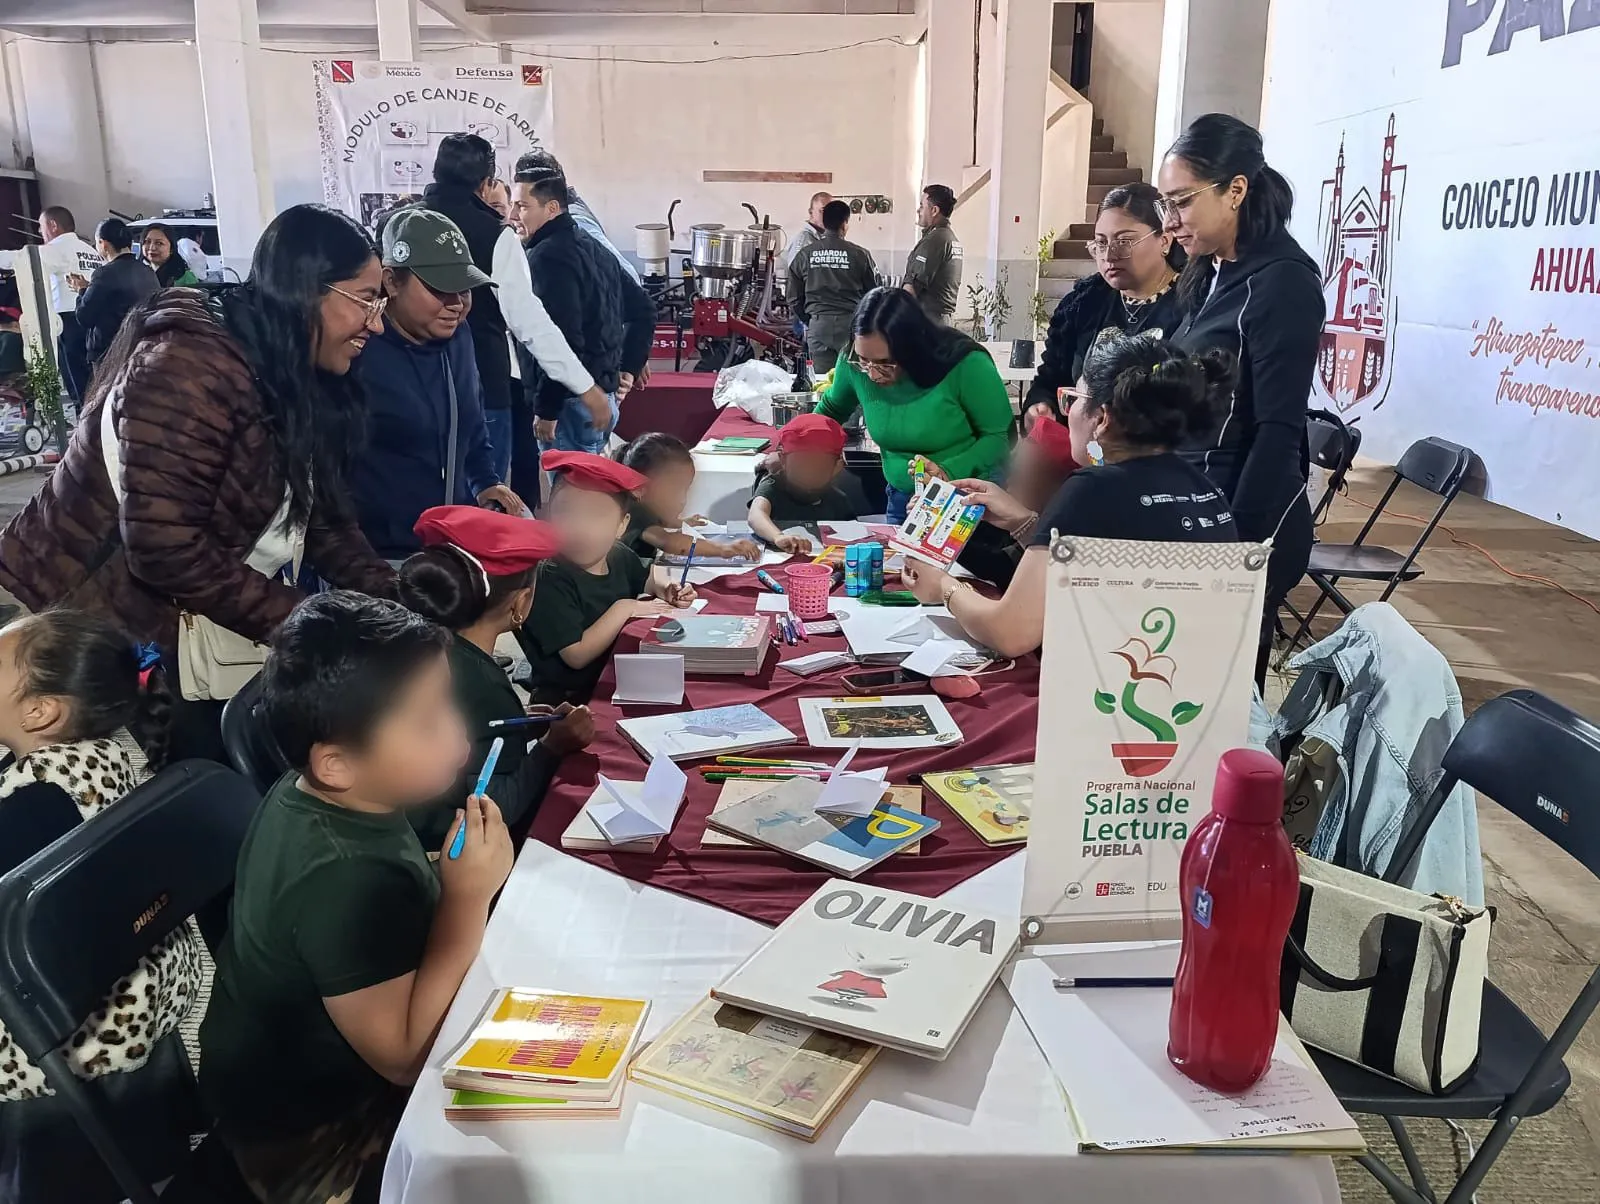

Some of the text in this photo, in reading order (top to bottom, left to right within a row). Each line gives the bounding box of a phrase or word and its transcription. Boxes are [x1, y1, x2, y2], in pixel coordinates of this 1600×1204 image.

[1441, 0, 1600, 69] PA
[456, 67, 514, 77] Defensa
[343, 101, 390, 163] MODULO
[393, 90, 418, 107] DE
[421, 87, 479, 105] CANJE
[482, 96, 507, 116] DE
[1442, 175, 1540, 231] CONCEJO
[809, 256, 850, 264] FORESTAL
[812, 249, 848, 257] GUARDIA
[1530, 248, 1600, 294] AHUA
[1086, 780, 1196, 793] Programa Nacional
[1084, 791, 1189, 816] Salas de
[1082, 818, 1188, 842] Lectura
[1082, 843, 1143, 858] PUEBLA
[813, 889, 996, 955] OLIVIA
[1294, 1121, 1326, 1129] FERIA
